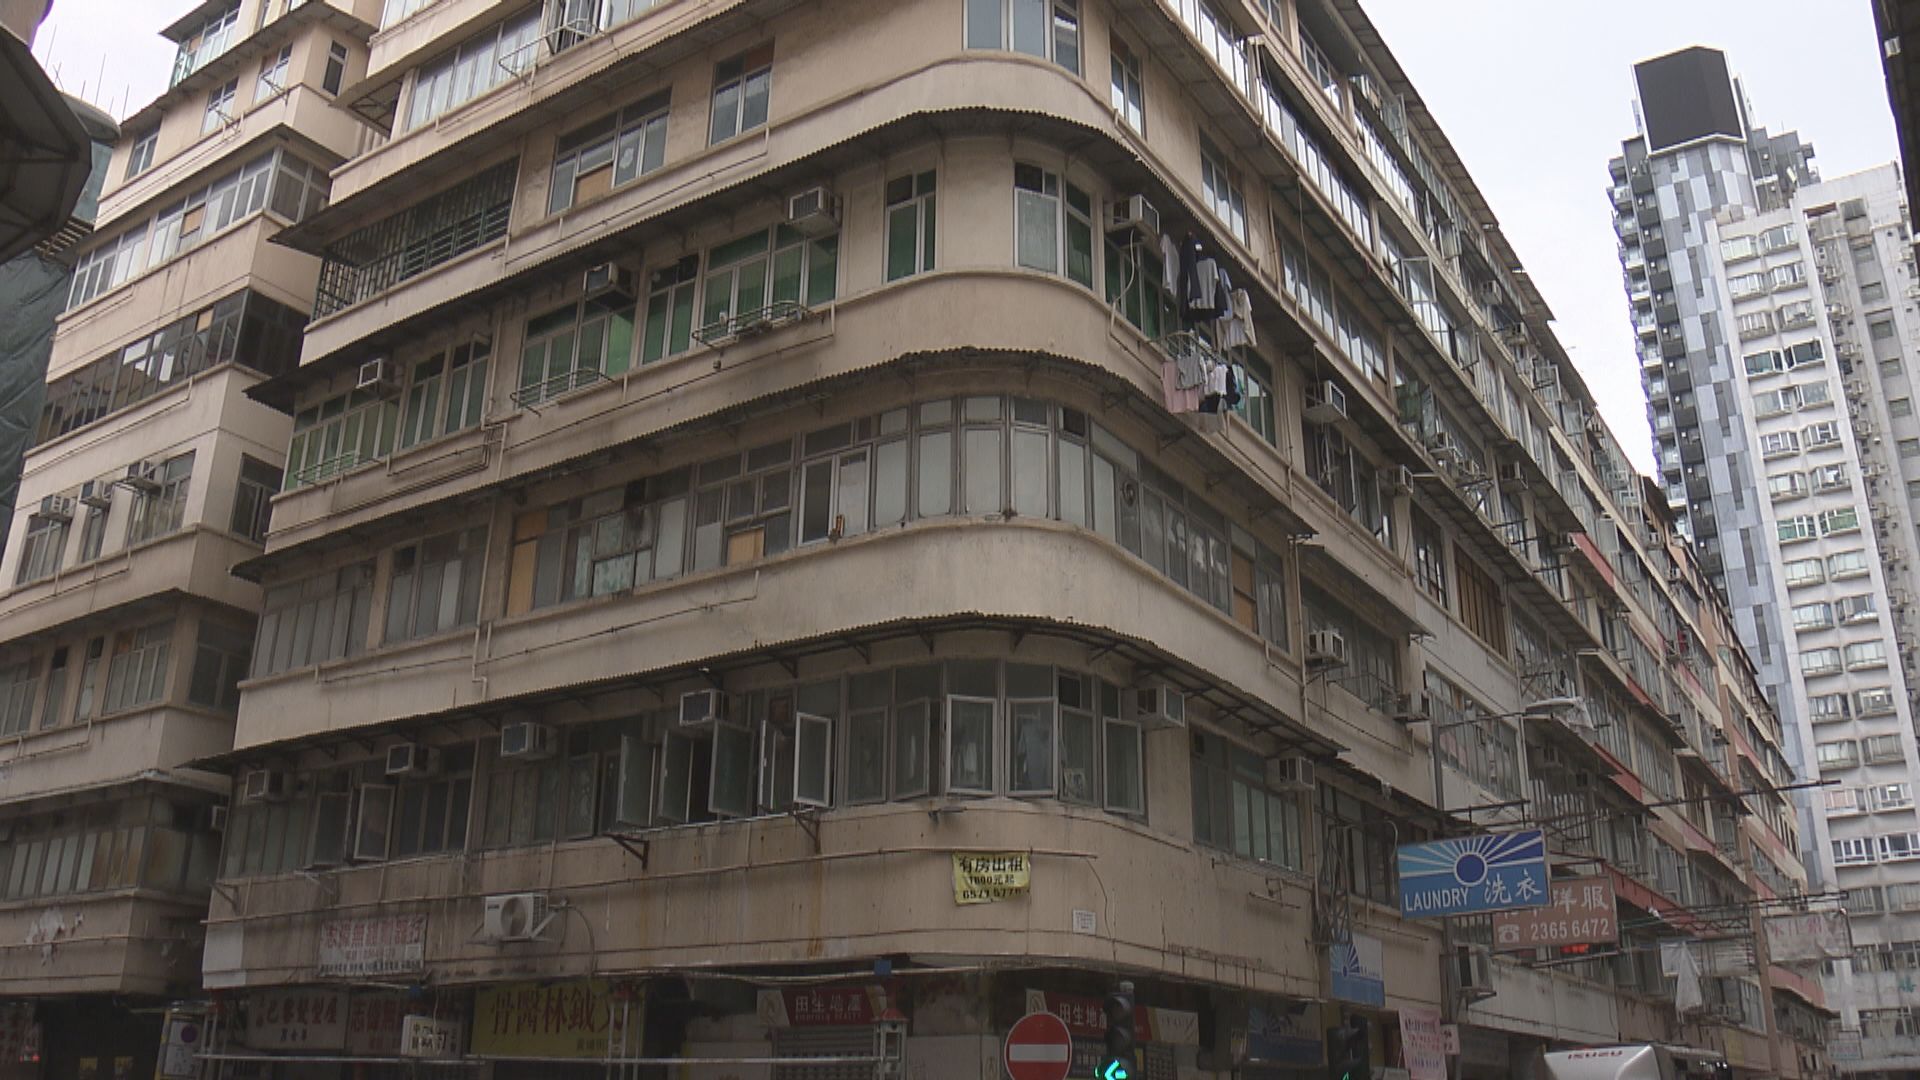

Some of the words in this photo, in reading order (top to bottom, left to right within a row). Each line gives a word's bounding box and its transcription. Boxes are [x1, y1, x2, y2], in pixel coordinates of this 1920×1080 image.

[960, 856, 1023, 873] 有房出租
[1405, 887, 1468, 912] LAUNDRY
[1484, 868, 1542, 905] 洗衣
[1530, 921, 1567, 941] 2365
[1571, 918, 1609, 938] 6472
